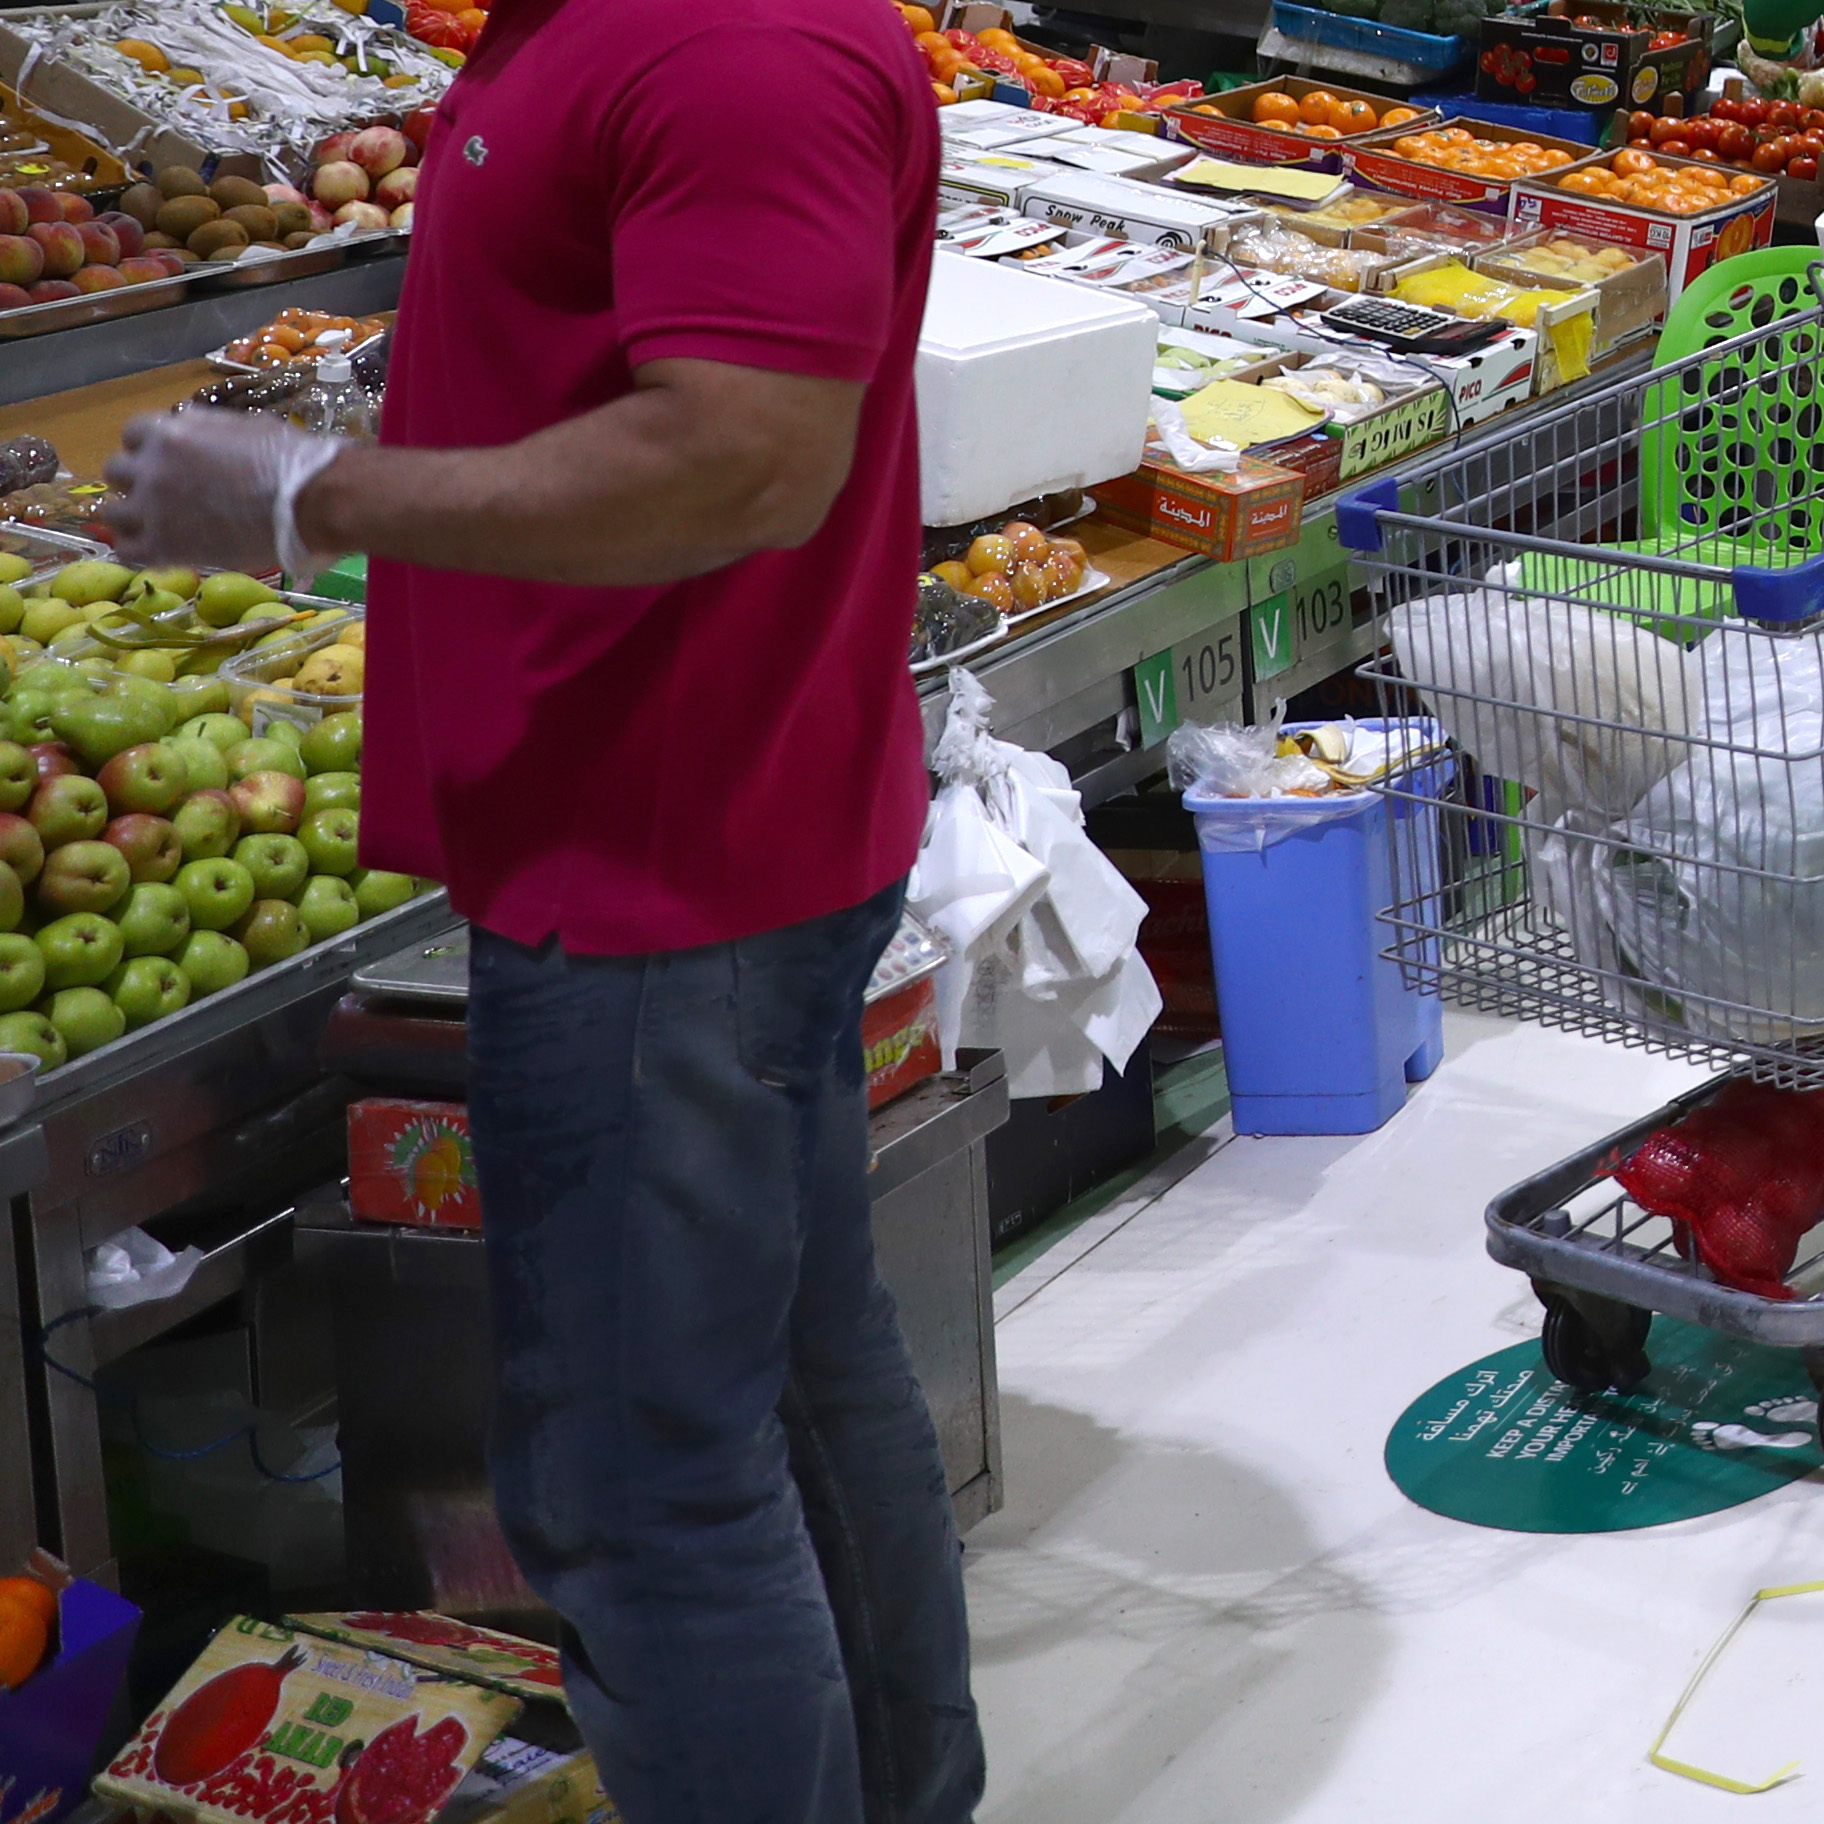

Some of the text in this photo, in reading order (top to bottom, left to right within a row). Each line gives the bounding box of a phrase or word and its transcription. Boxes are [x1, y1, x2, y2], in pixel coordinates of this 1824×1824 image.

[1014, 223, 1049, 238] PICO
[1091, 214, 1126, 234] Peak
[1459, 378, 1482, 404] PICO
[1158, 496, 1212, 529] المدينة
[1251, 504, 1289, 526] المدينة
[1258, 580, 1345, 660] V 103
[1143, 634, 1236, 725] V 105
[1486, 1428, 1523, 1459] KEEP
[1516, 1418, 1538, 1430] A
[1529, 1378, 1571, 1418] DISTA
[1514, 1425, 1556, 1461] YOUR
[1544, 1412, 1598, 1463] IMPORTA
